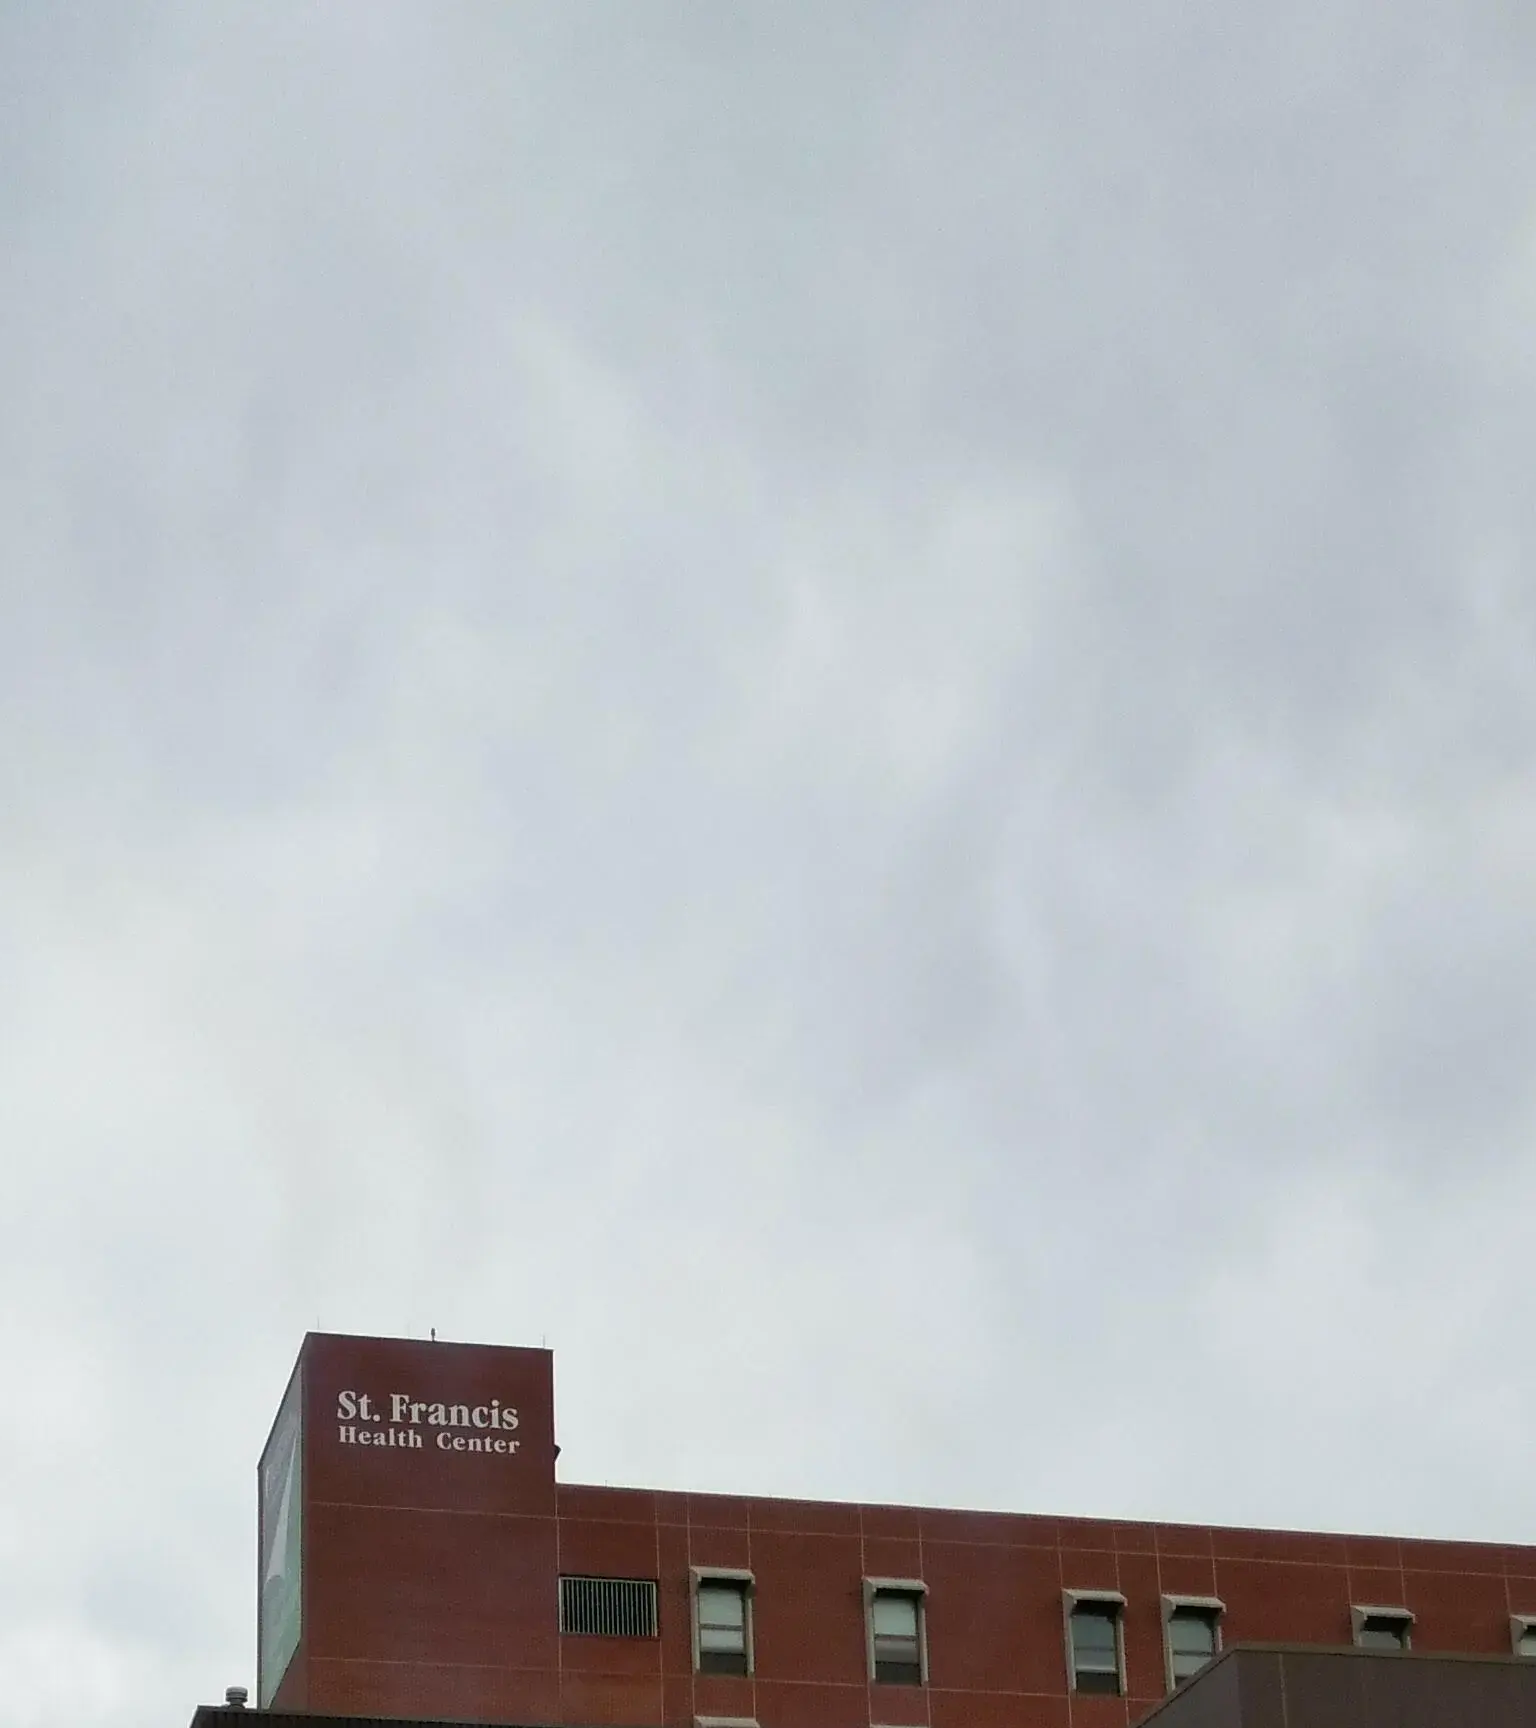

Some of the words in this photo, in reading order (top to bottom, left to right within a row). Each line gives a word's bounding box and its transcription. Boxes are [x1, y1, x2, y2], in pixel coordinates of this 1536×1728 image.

[337, 1390, 381, 1422] St.
[389, 1393, 519, 1430] Francis
[339, 1425, 423, 1449] Health
[436, 1432, 521, 1454] Center
